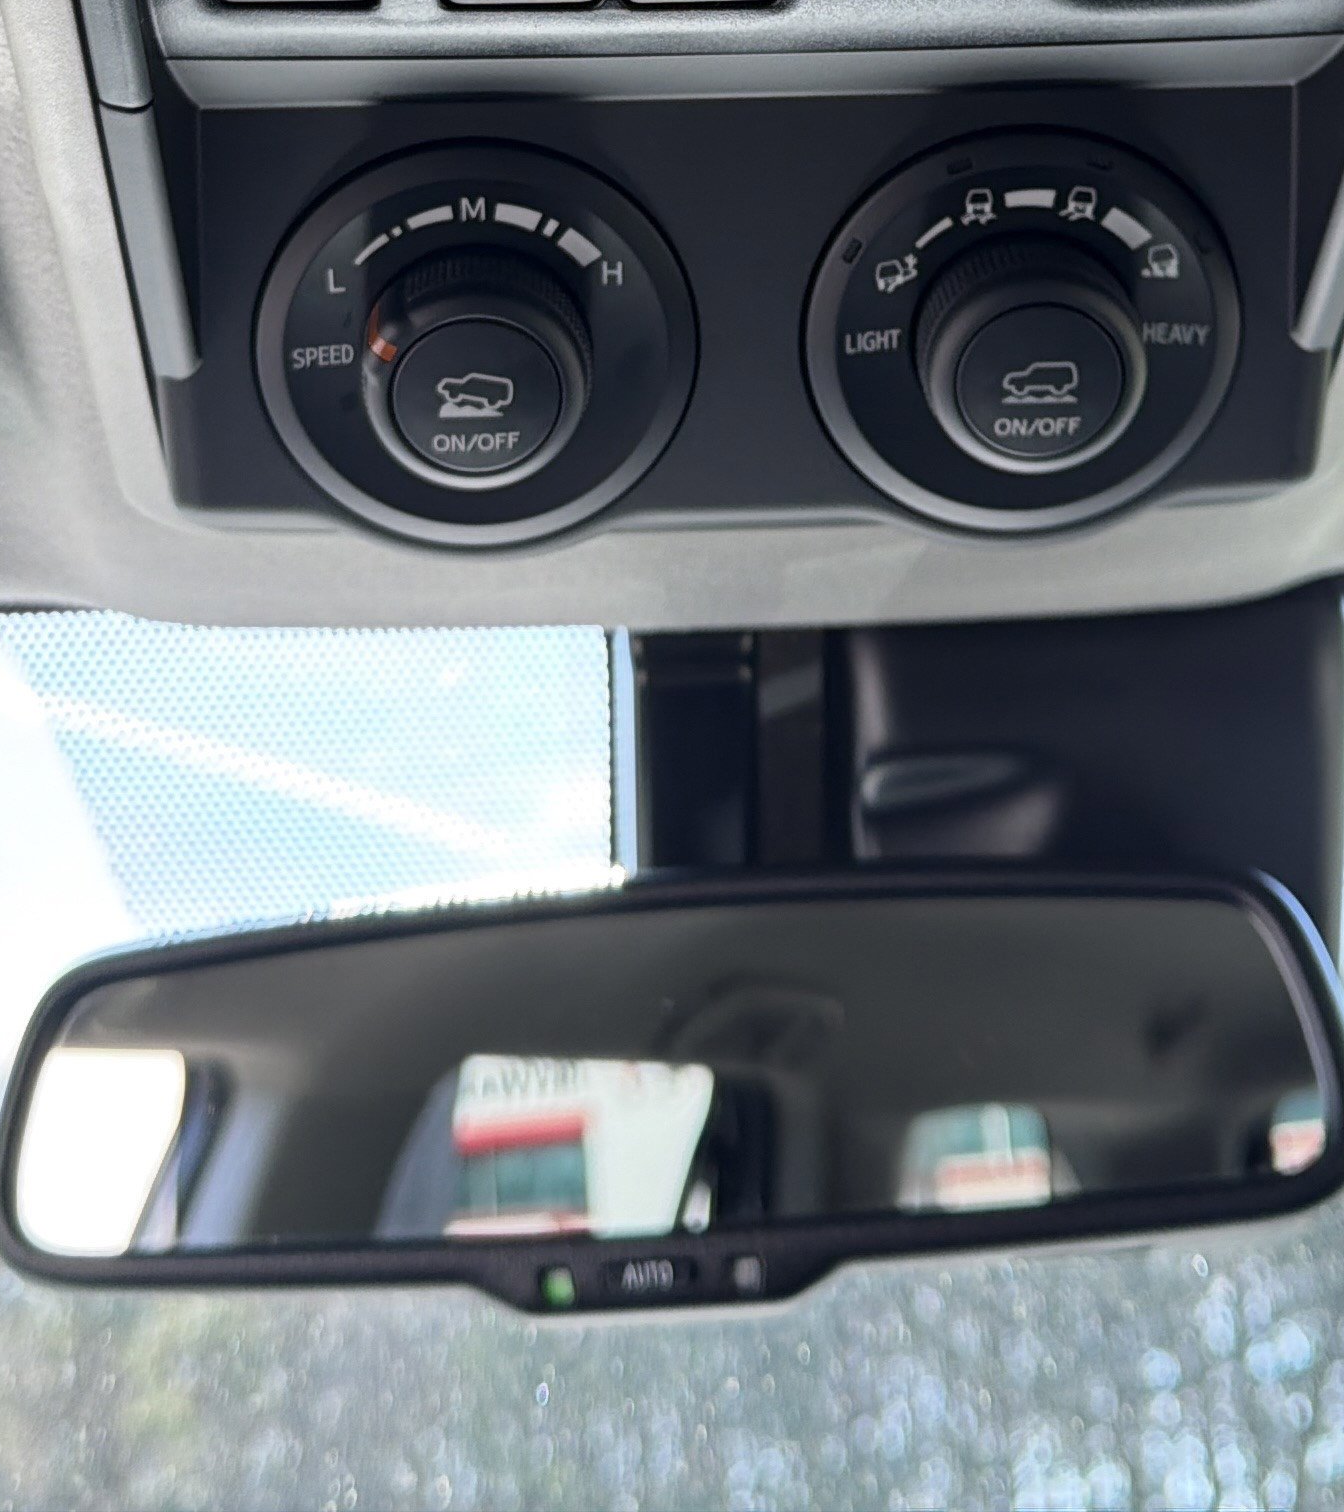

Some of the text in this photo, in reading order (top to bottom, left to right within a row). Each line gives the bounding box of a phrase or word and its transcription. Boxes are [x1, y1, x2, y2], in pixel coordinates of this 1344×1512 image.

[460, 197, 486, 221] M
[328, 268, 346, 293] L
[602, 261, 622, 286] H
[845, 329, 901, 355] LIGHT
[1142, 322, 1211, 346] HEAVY
[292, 344, 354, 369] SPEED
[994, 417, 1081, 438] ON/OFF
[433, 430, 520, 453] ON/OFF
[621, 1258, 674, 1291] AUTO
